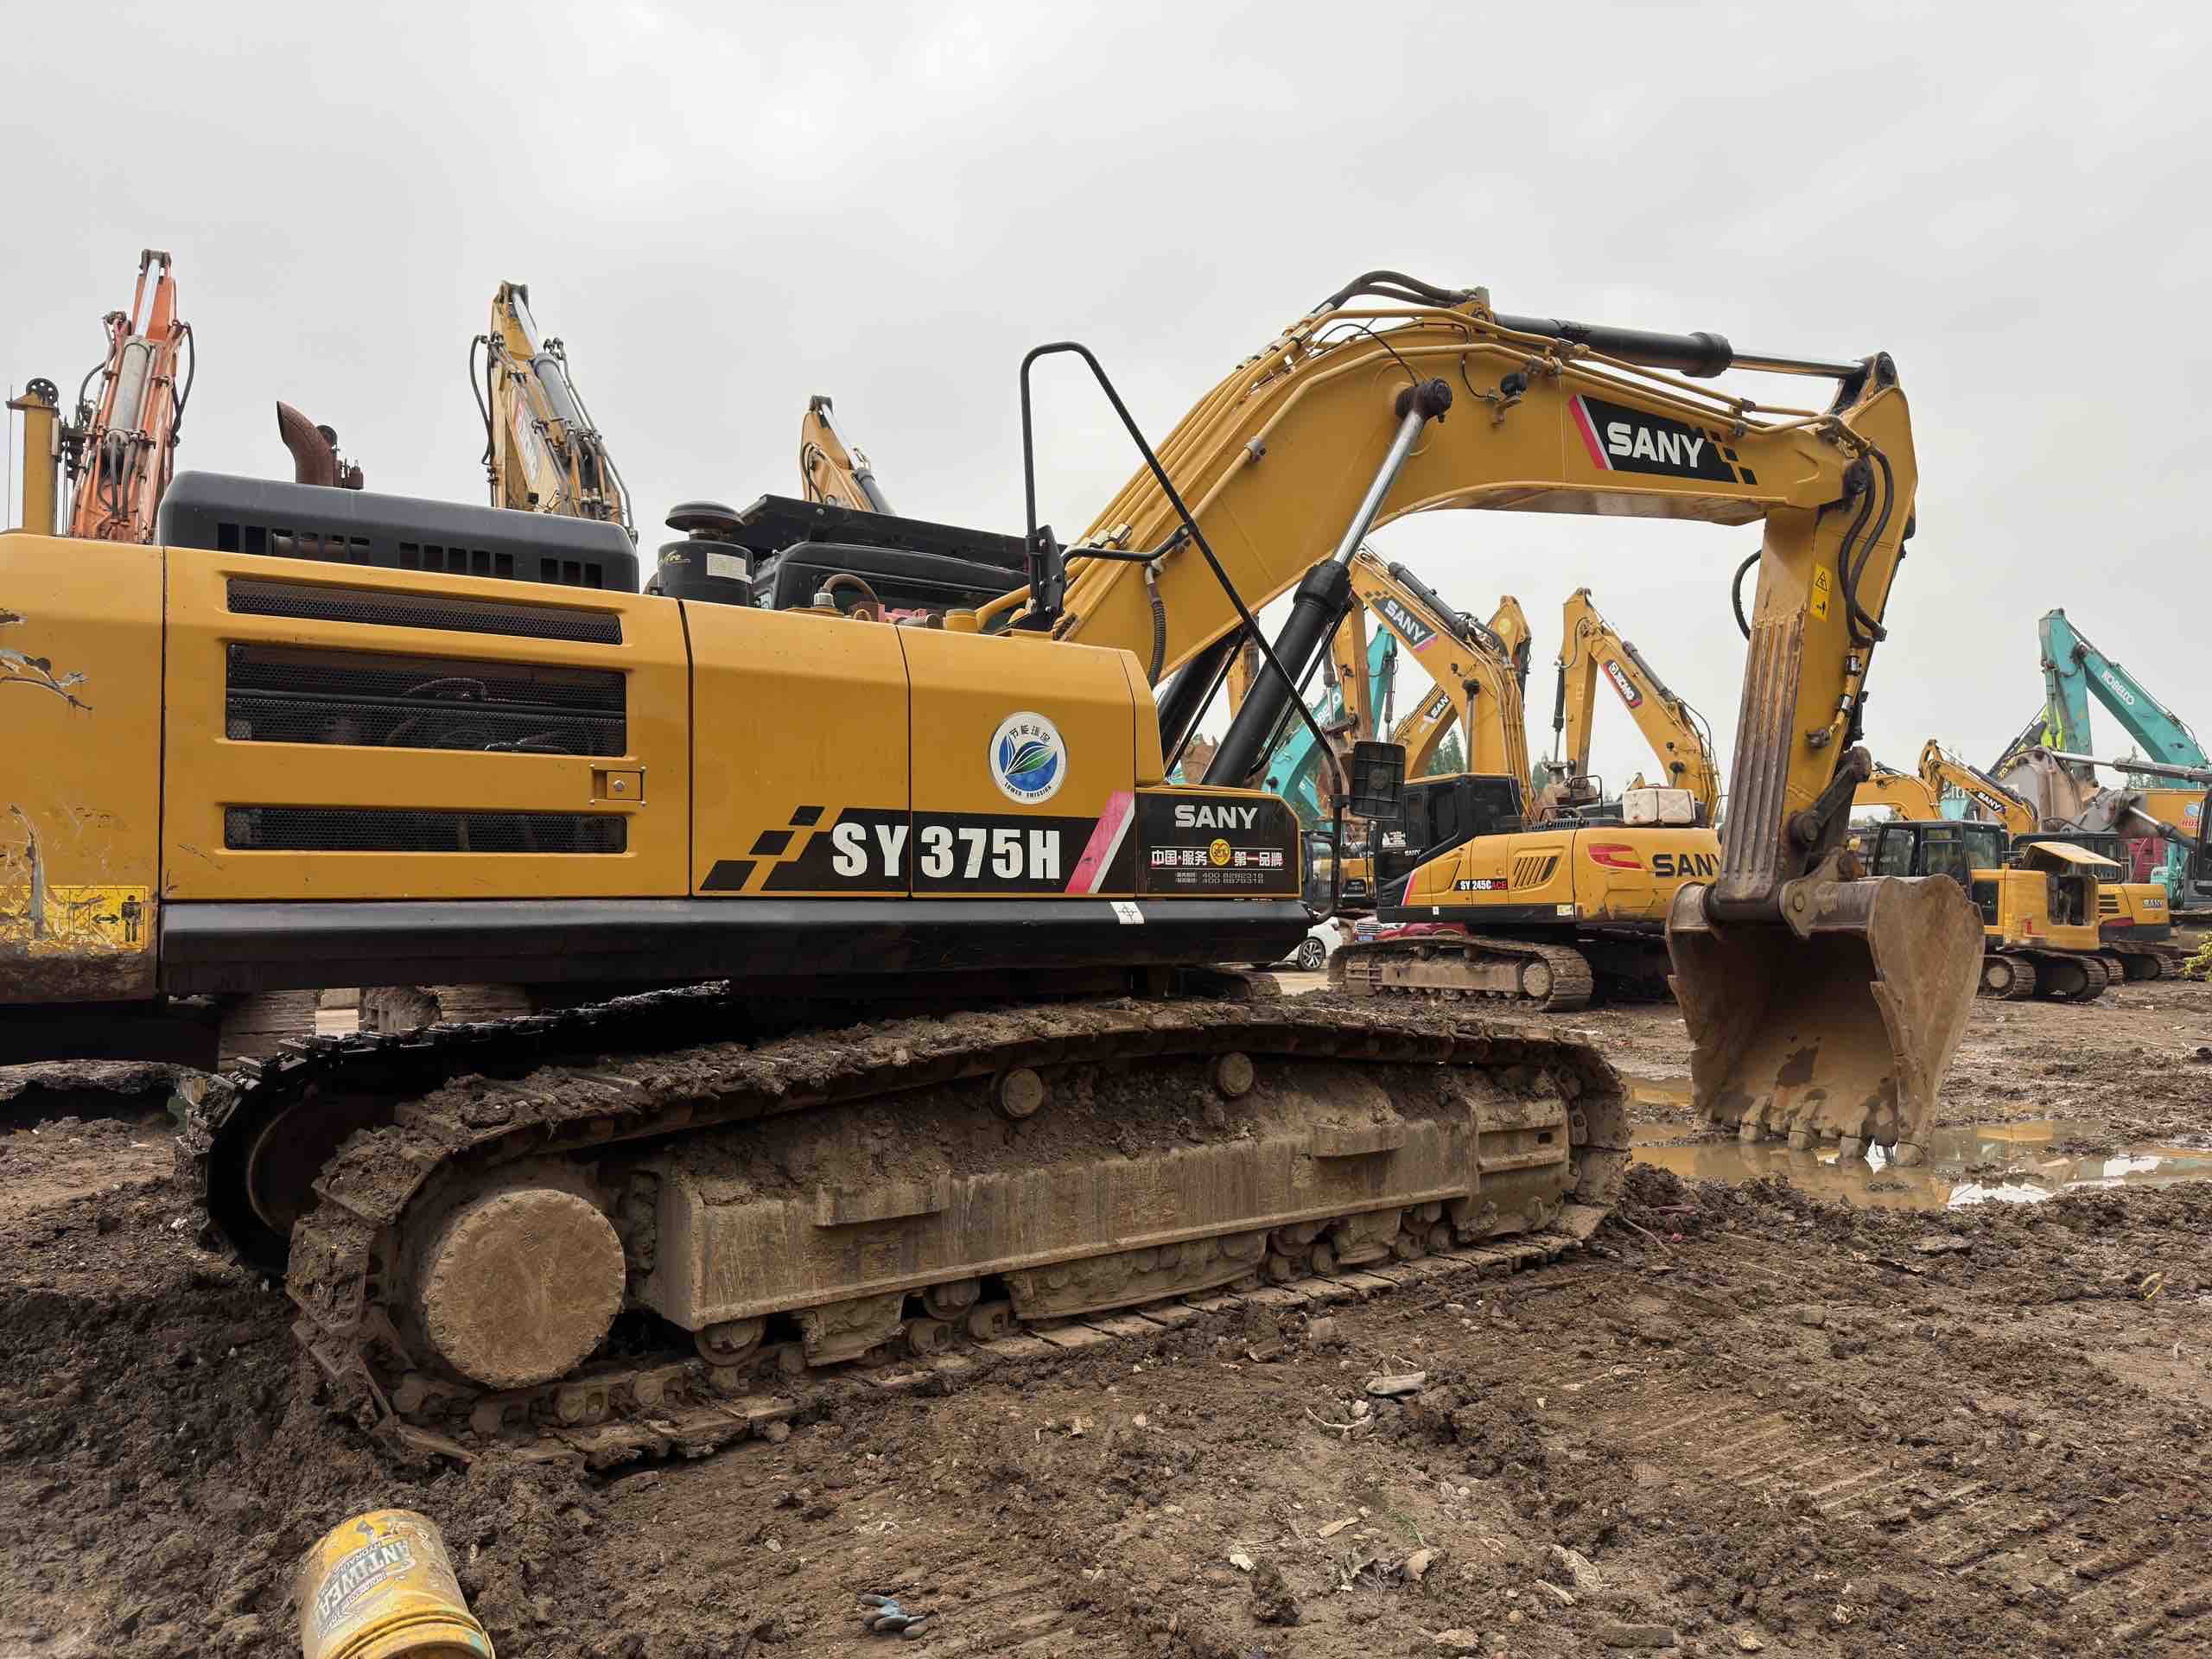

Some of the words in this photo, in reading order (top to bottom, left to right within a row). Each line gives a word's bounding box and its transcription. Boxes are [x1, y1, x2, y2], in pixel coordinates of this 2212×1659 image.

[1607, 422, 1705, 468] SANY
[1385, 600, 1426, 641] SANY
[1977, 791, 2001, 810] SANY
[1175, 804, 1258, 830] SANY
[1234, 851, 1283, 867] 第一品牌
